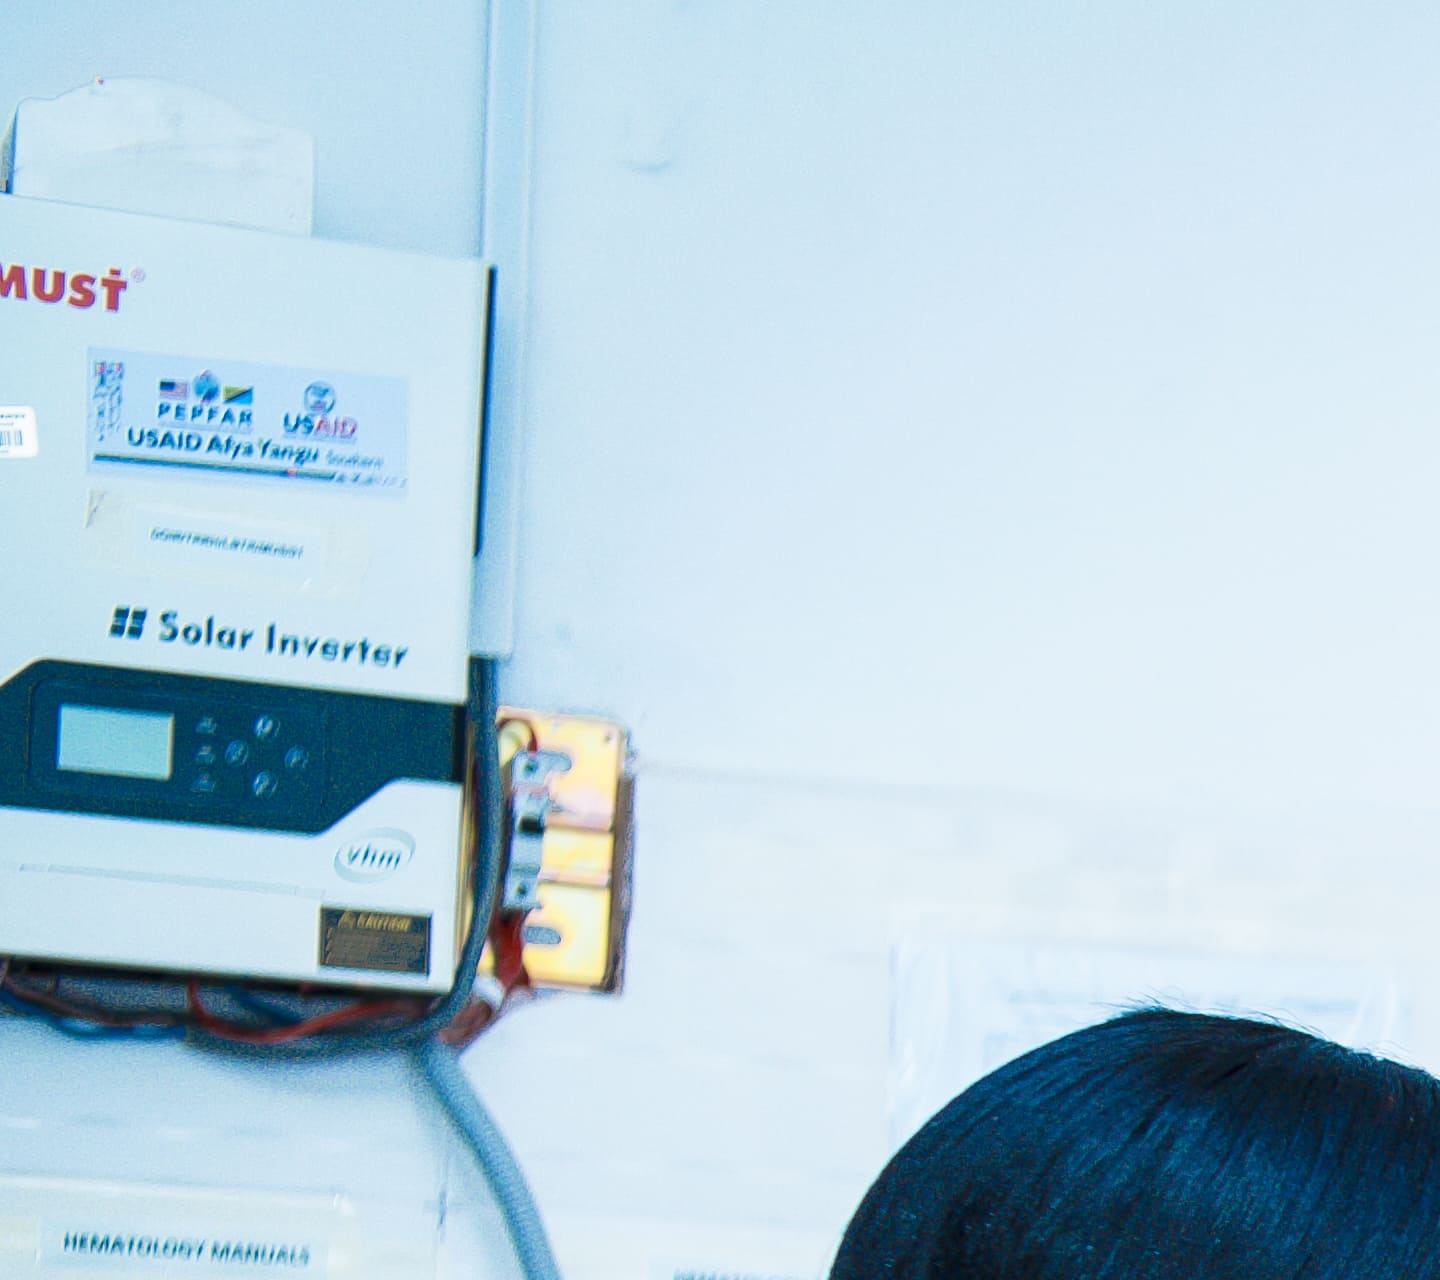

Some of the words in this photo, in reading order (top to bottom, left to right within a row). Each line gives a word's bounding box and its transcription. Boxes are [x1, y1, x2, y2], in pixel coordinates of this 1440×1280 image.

[127, 427, 201, 451] USAID
[283, 412, 358, 439] USAID
[159, 610, 254, 648] Solar
[266, 621, 410, 671] Inverter
[63, 1231, 205, 1262] HEMATOLOGY
[210, 1238, 311, 1268] MANUALS
